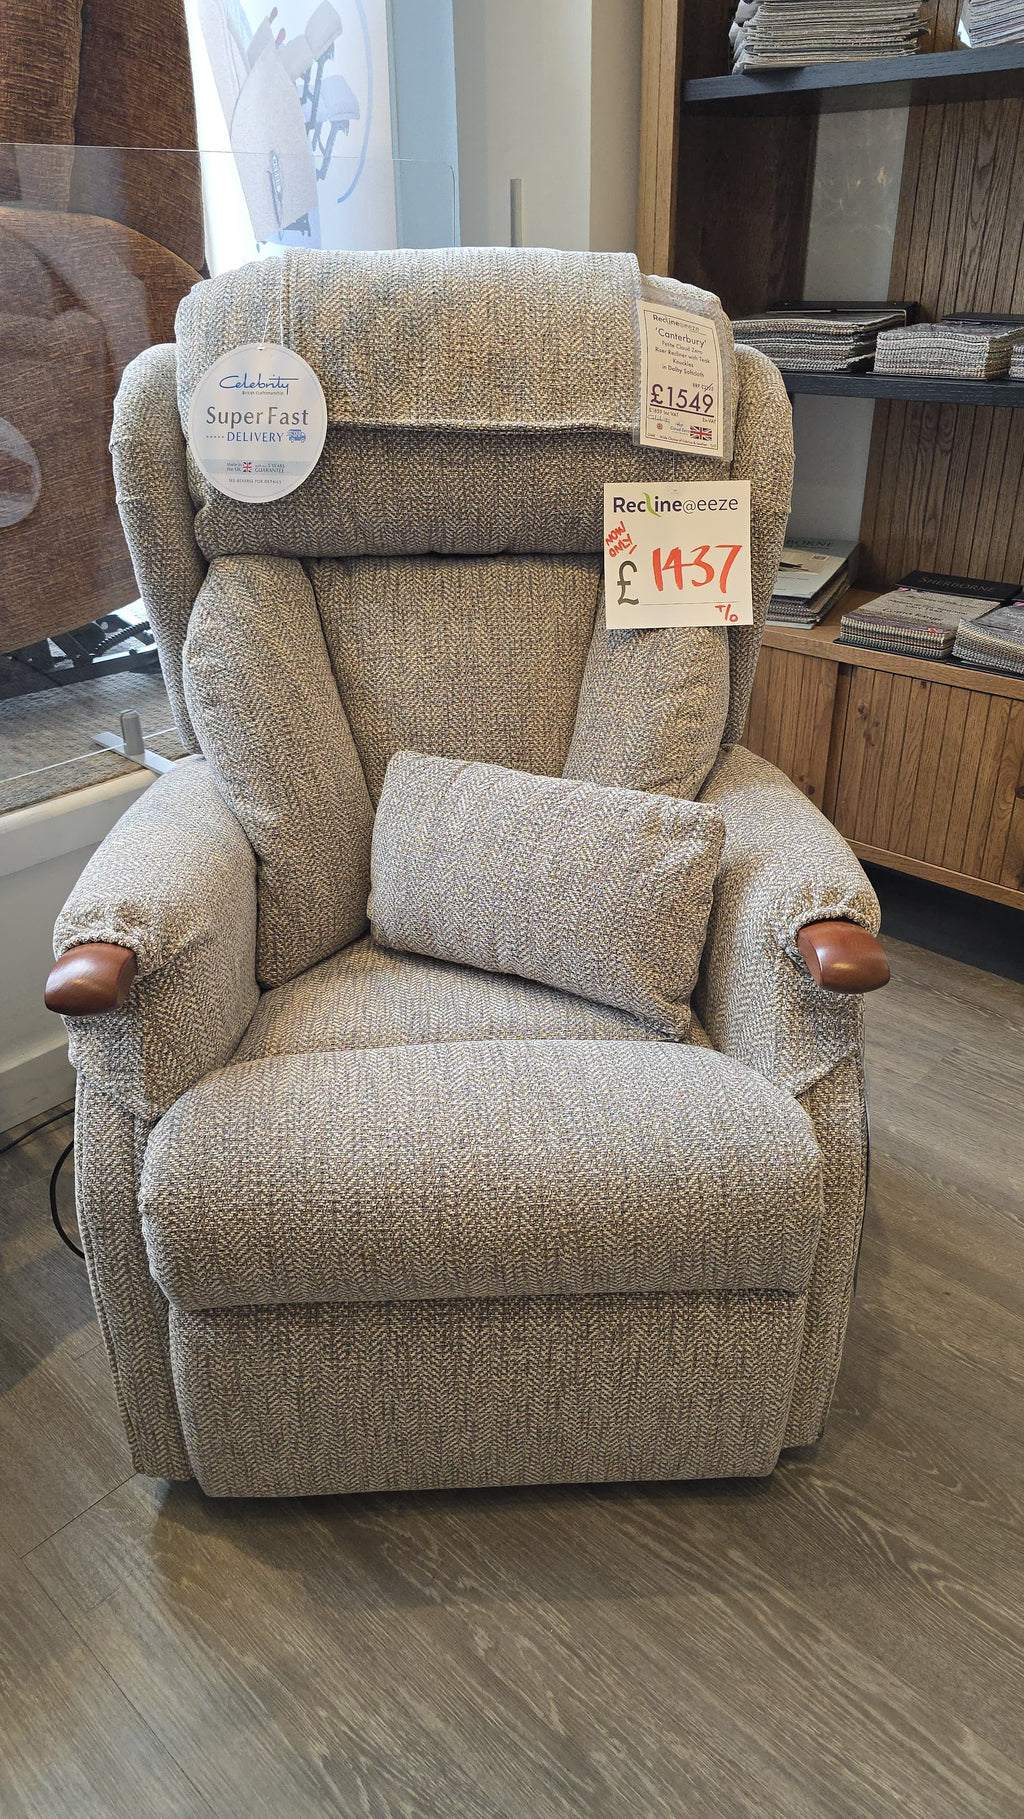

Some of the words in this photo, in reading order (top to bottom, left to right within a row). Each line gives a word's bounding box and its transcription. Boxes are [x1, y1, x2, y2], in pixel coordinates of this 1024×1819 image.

[655, 327, 707, 349] 'Canterbury'
[661, 340, 675, 348] Petite
[668, 349, 687, 358] Recliner
[672, 358, 694, 368] Knuckles
[219, 372, 299, 395] Celebrity
[650, 384, 714, 414] £1549
[206, 406, 263, 429] Super
[268, 406, 309, 426] Fast
[227, 431, 284, 443] DELIVERY
[605, 520, 626, 546] NOW
[652, 545, 743, 594] 1437
[919, 576, 998, 592] SHERBORNE
